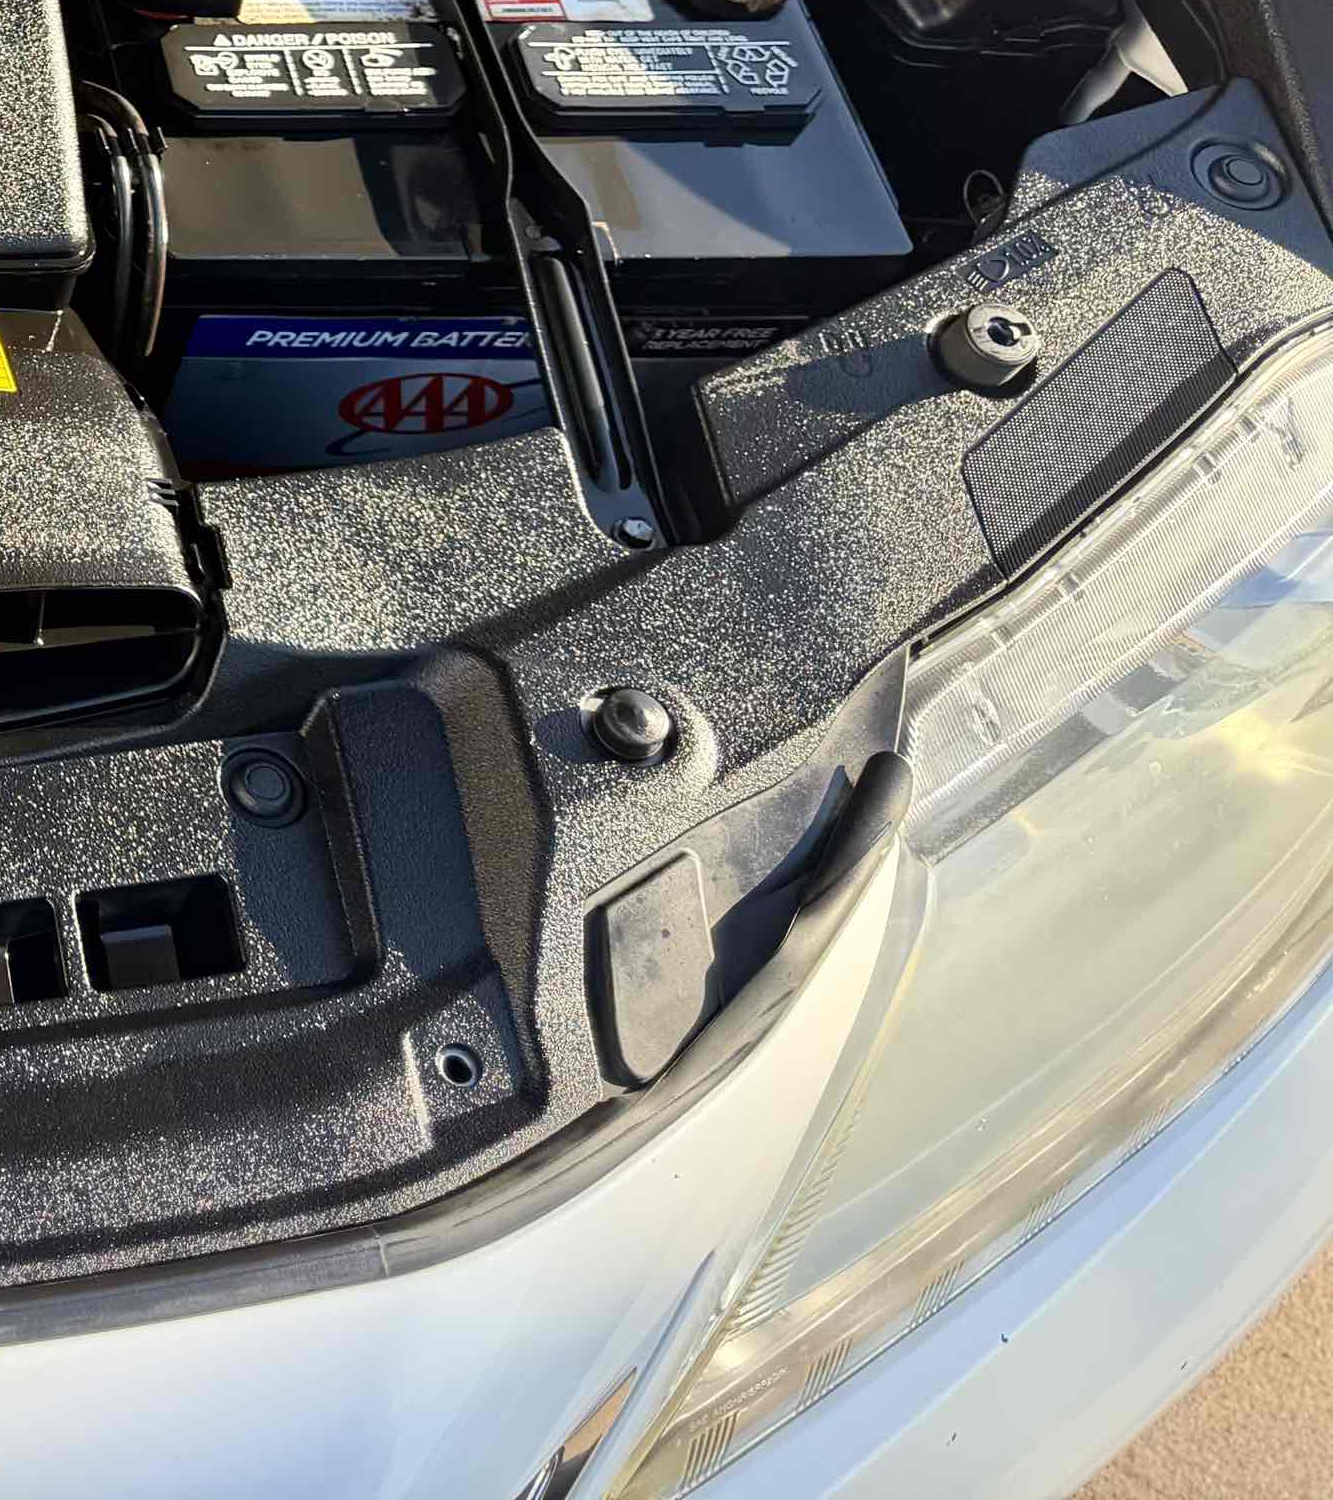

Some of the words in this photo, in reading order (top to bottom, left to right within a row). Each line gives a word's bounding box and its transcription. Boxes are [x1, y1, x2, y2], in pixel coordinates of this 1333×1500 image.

[232, 33, 309, 46] DANGER
[326, 32, 397, 45] POISON
[245, 328, 413, 350] PREMIUM
[414, 330, 534, 349] BATTER
[344, 374, 509, 432] AAA
